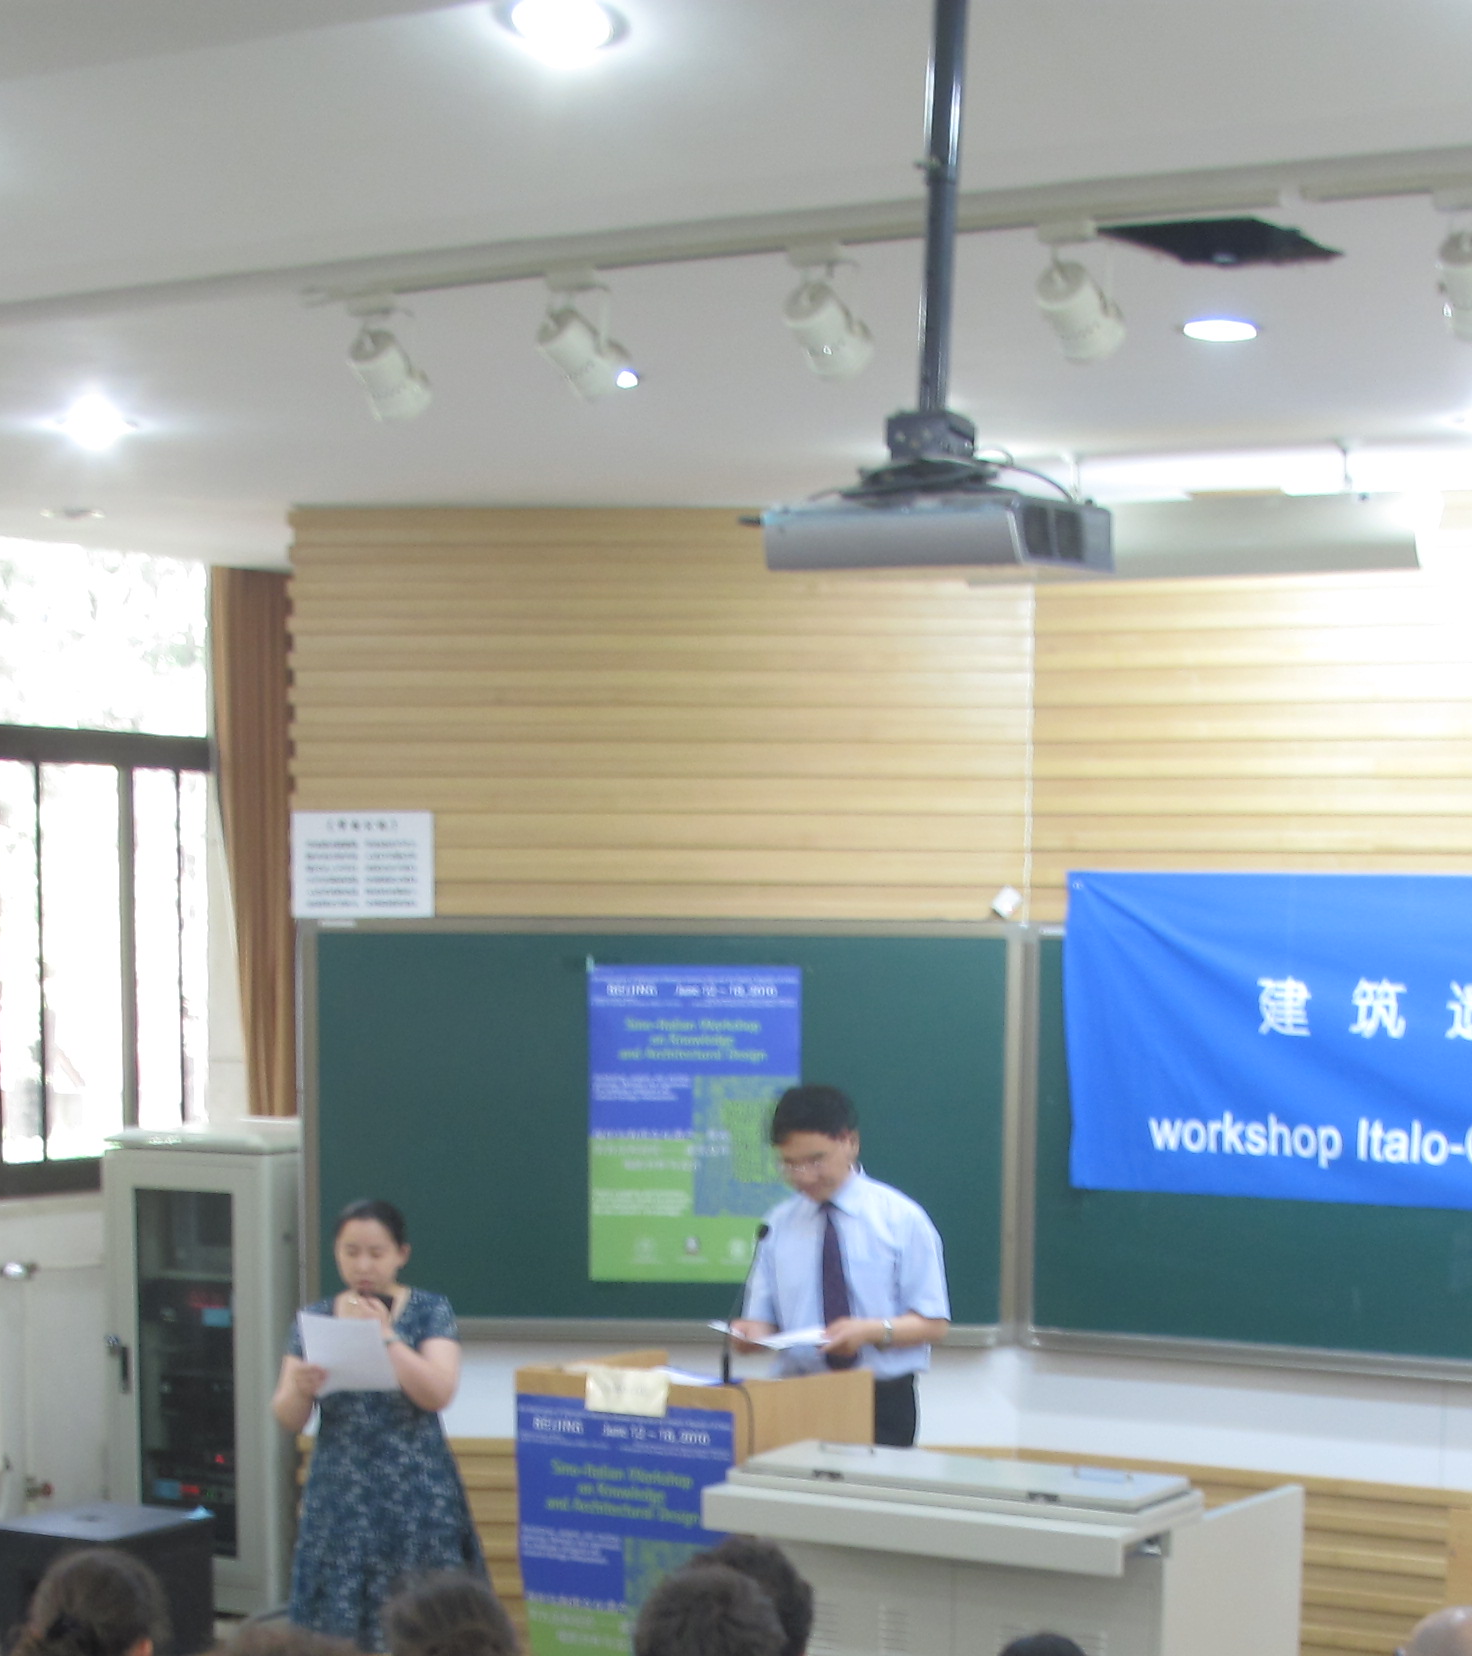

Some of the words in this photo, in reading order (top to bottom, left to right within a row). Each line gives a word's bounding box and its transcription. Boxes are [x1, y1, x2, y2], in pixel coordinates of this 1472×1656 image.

[1148, 1110, 1343, 1168] workshop
[533, 1416, 584, 1434] BEIJING
[602, 1422, 627, 1438] June
